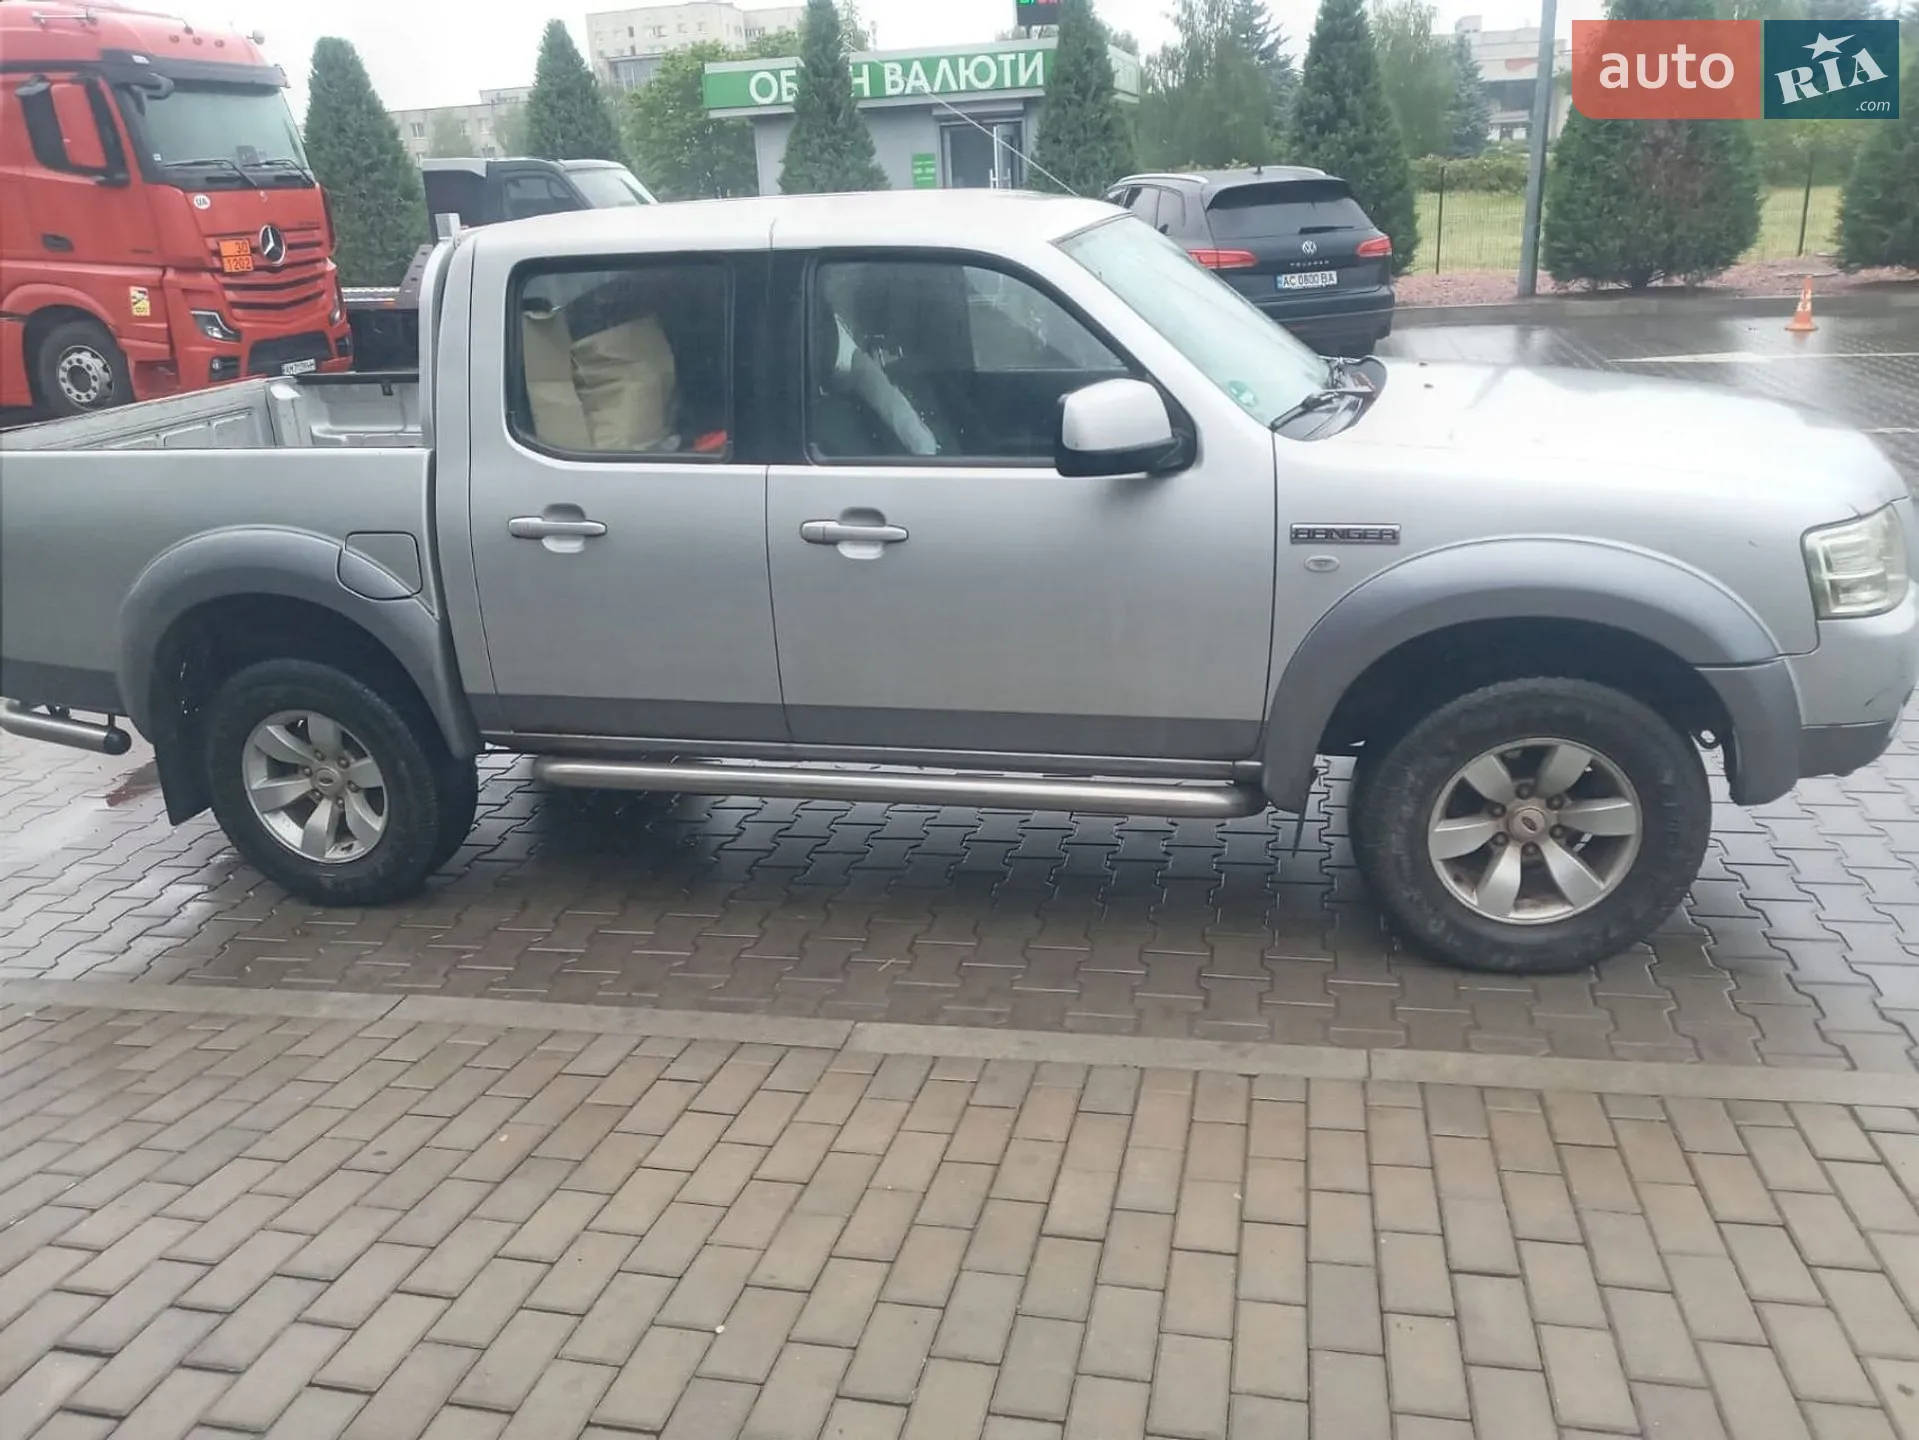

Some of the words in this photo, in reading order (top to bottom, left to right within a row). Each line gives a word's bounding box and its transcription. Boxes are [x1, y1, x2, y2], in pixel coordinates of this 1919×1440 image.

[749, 63, 871, 105] ОБН
[884, 51, 1044, 96] ВАЛЮТИ
[226, 257, 251, 271] 1202
[1295, 527, 1396, 540] RANGER
